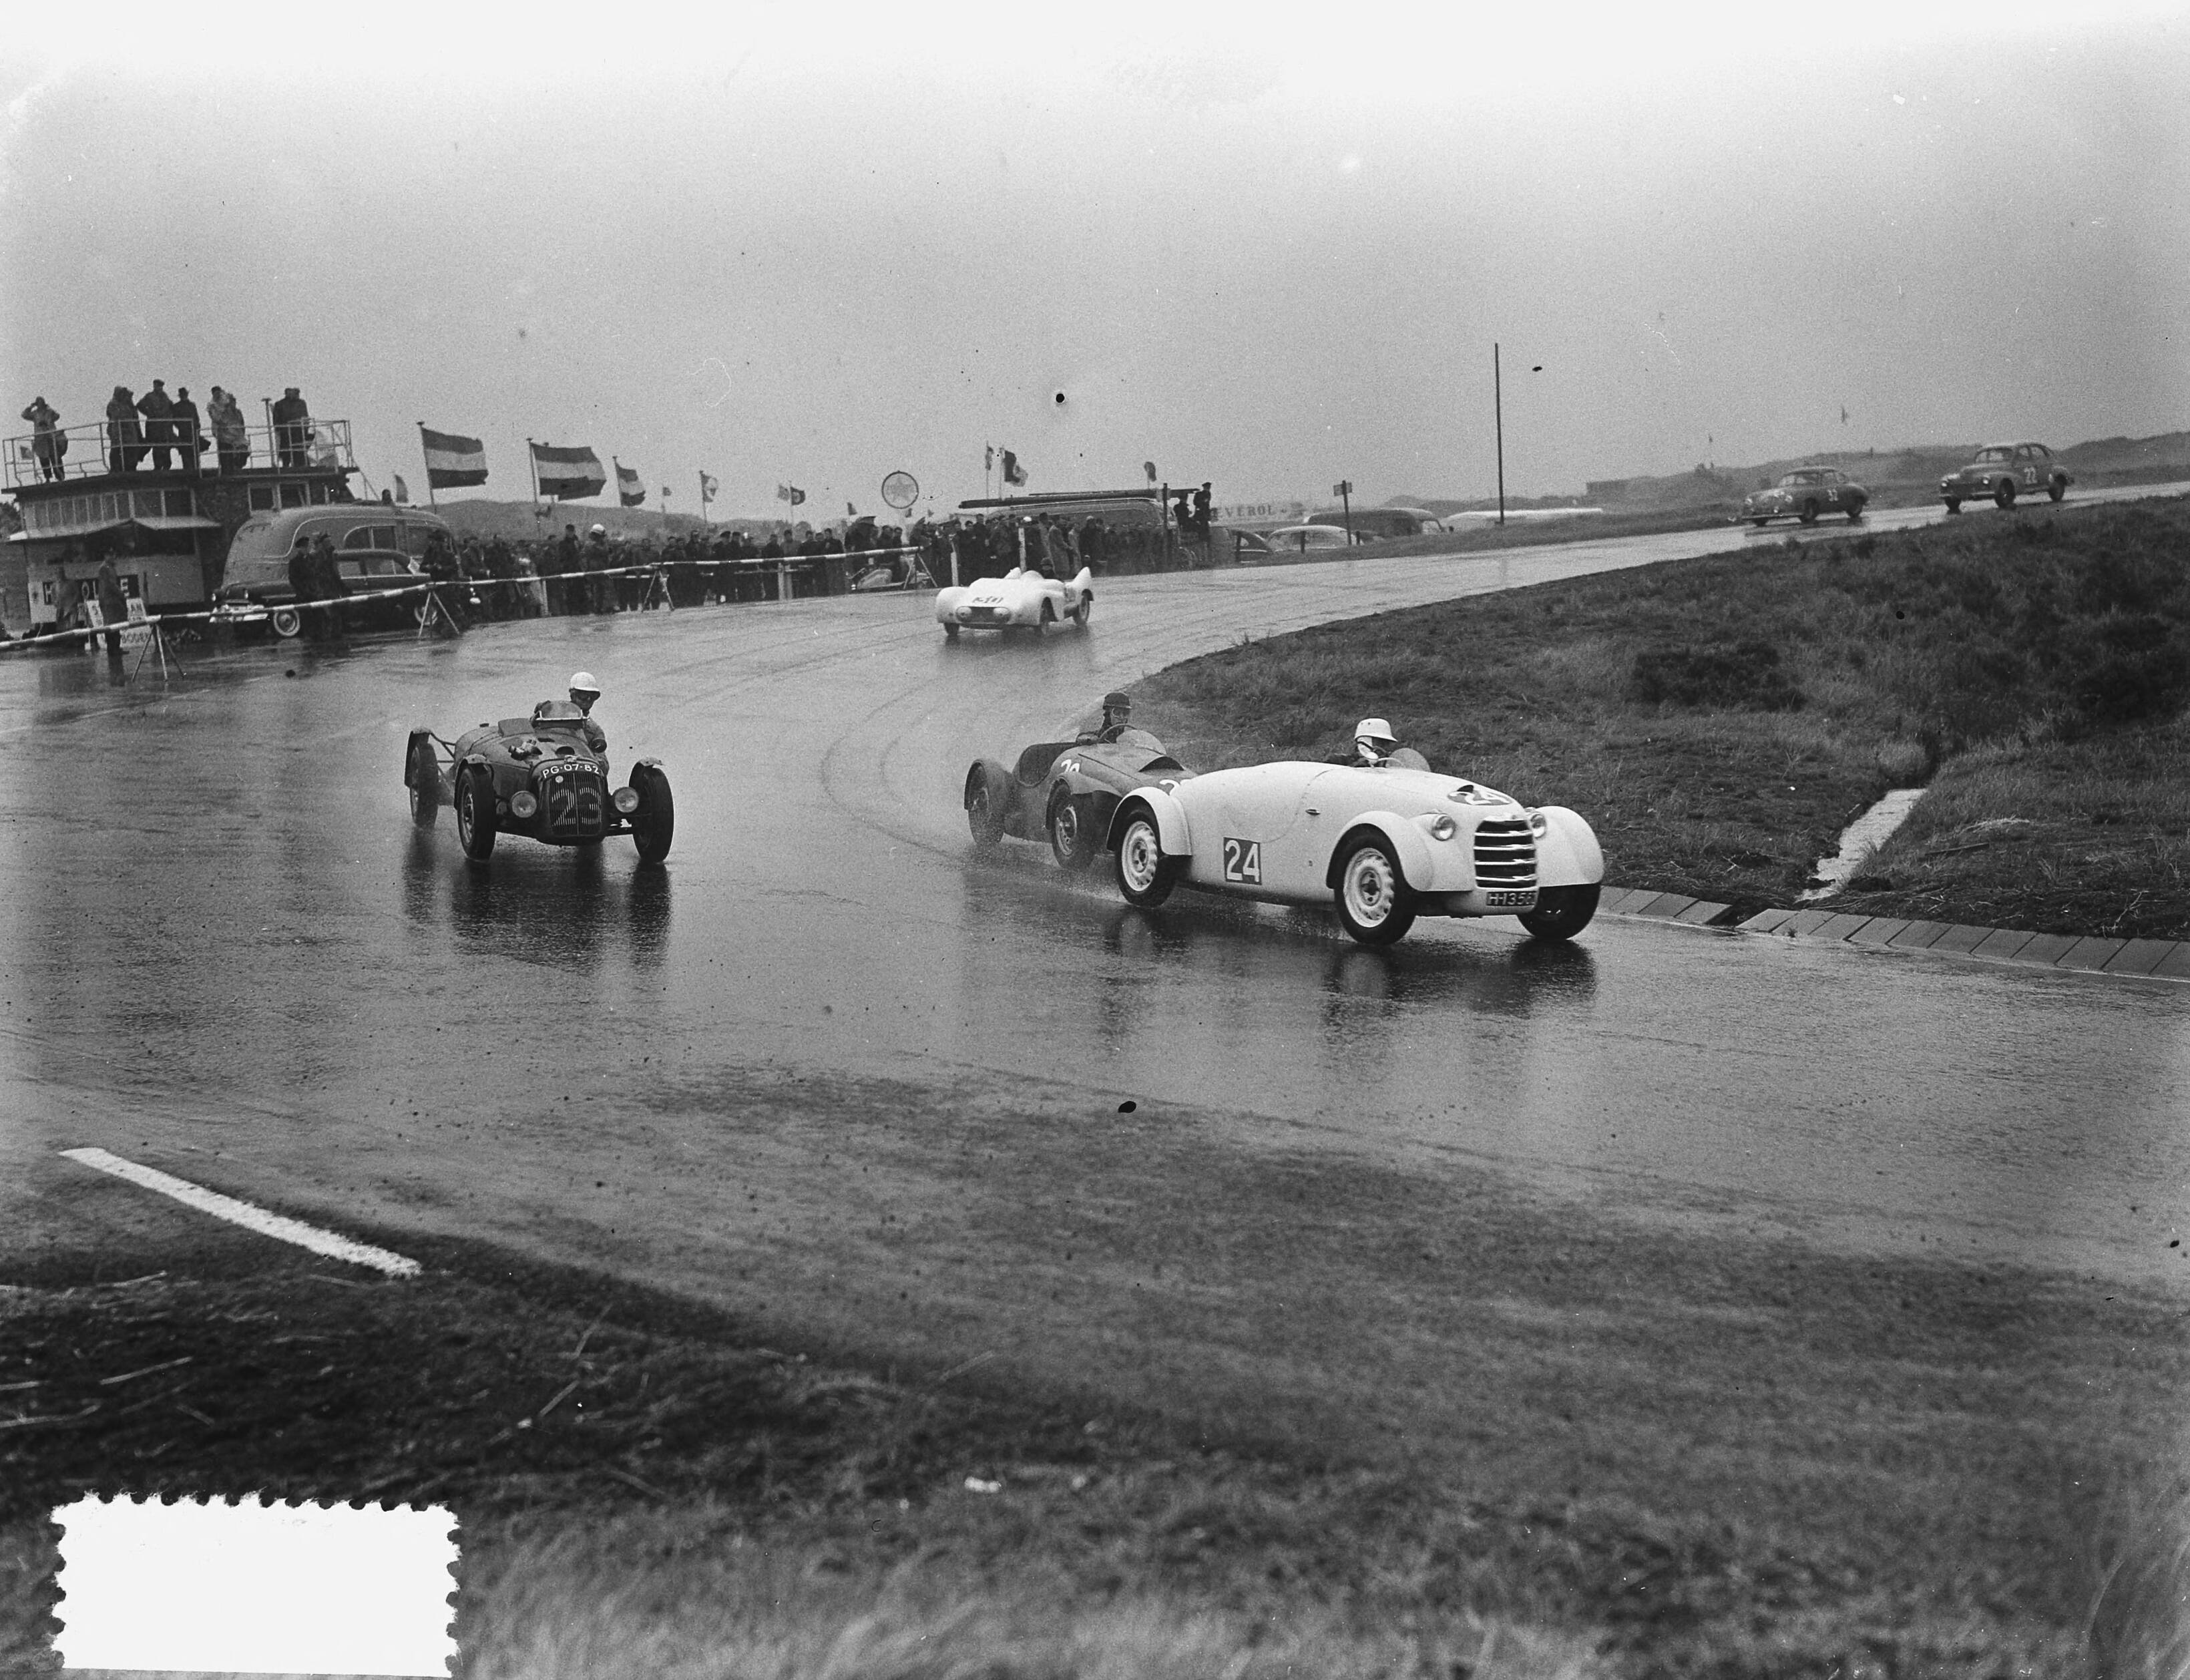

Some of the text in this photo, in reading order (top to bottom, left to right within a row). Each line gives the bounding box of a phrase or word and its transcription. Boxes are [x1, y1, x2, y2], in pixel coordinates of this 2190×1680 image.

[543, 764, 600, 779] PG-07-82
[552, 787, 602, 826] 23
[1225, 839, 1260, 883] 24
